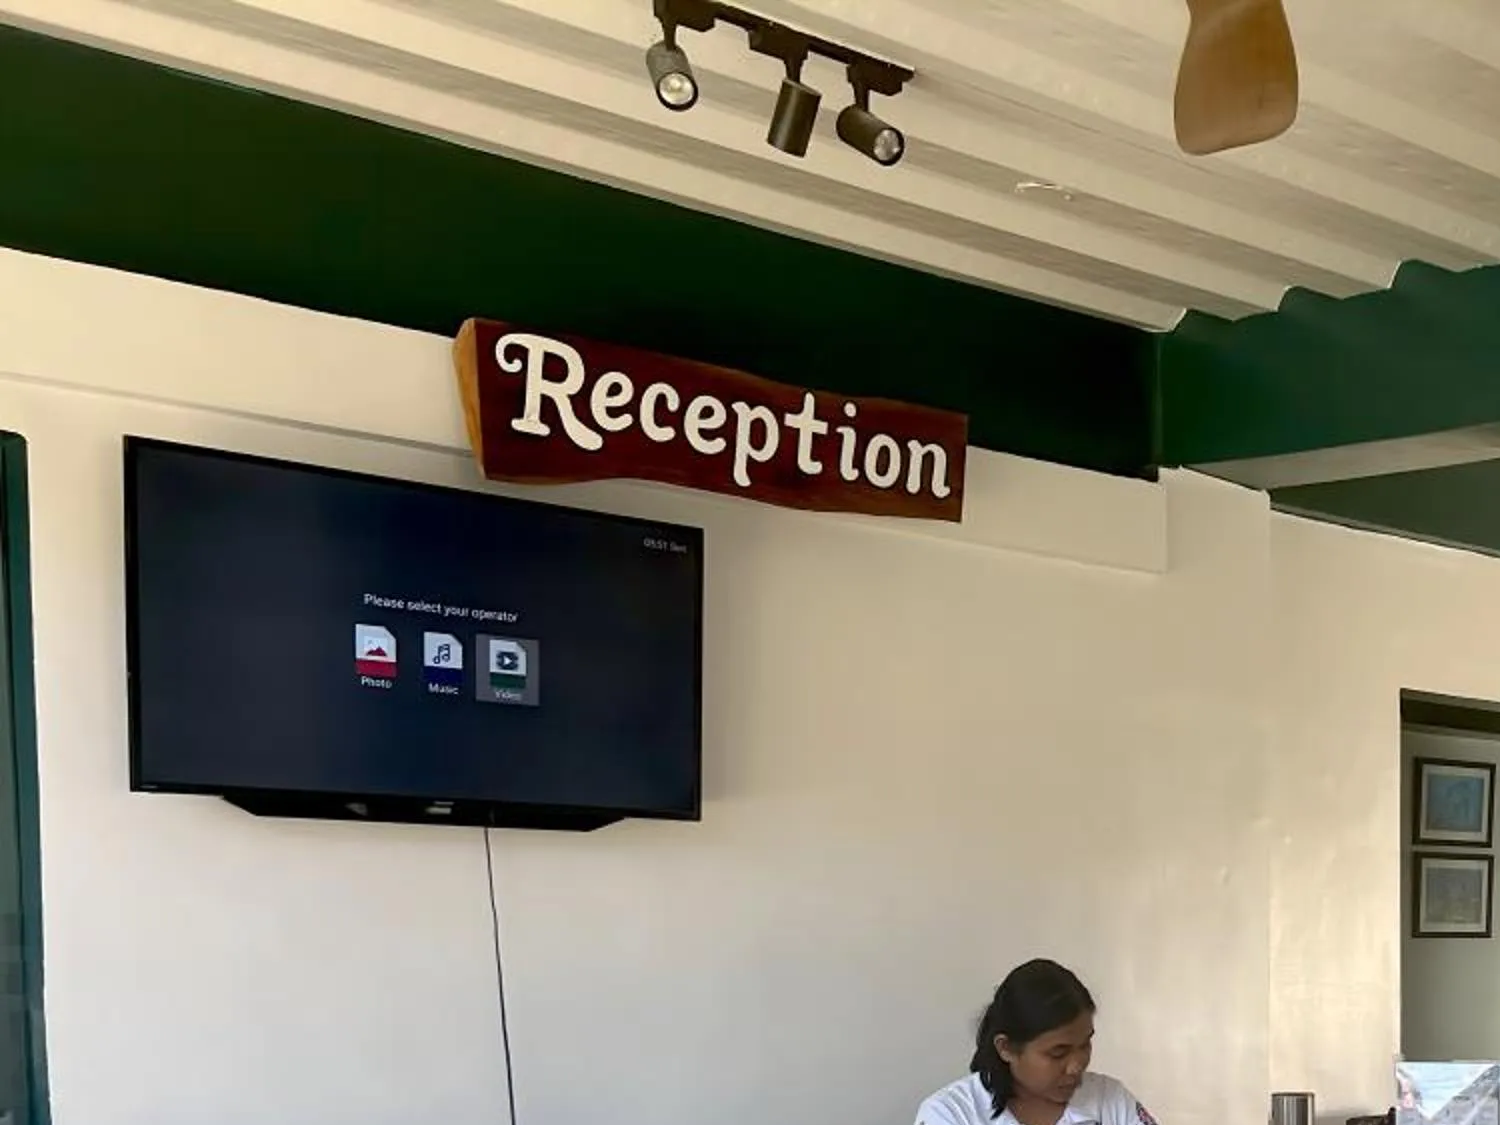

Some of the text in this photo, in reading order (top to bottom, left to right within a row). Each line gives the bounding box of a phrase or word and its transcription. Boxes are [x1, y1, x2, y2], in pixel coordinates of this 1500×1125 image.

[495, 333, 951, 499] Reception
[364, 593, 518, 623] Please select your operator
[361, 676, 393, 690] Photo
[428, 682, 459, 696] Music
